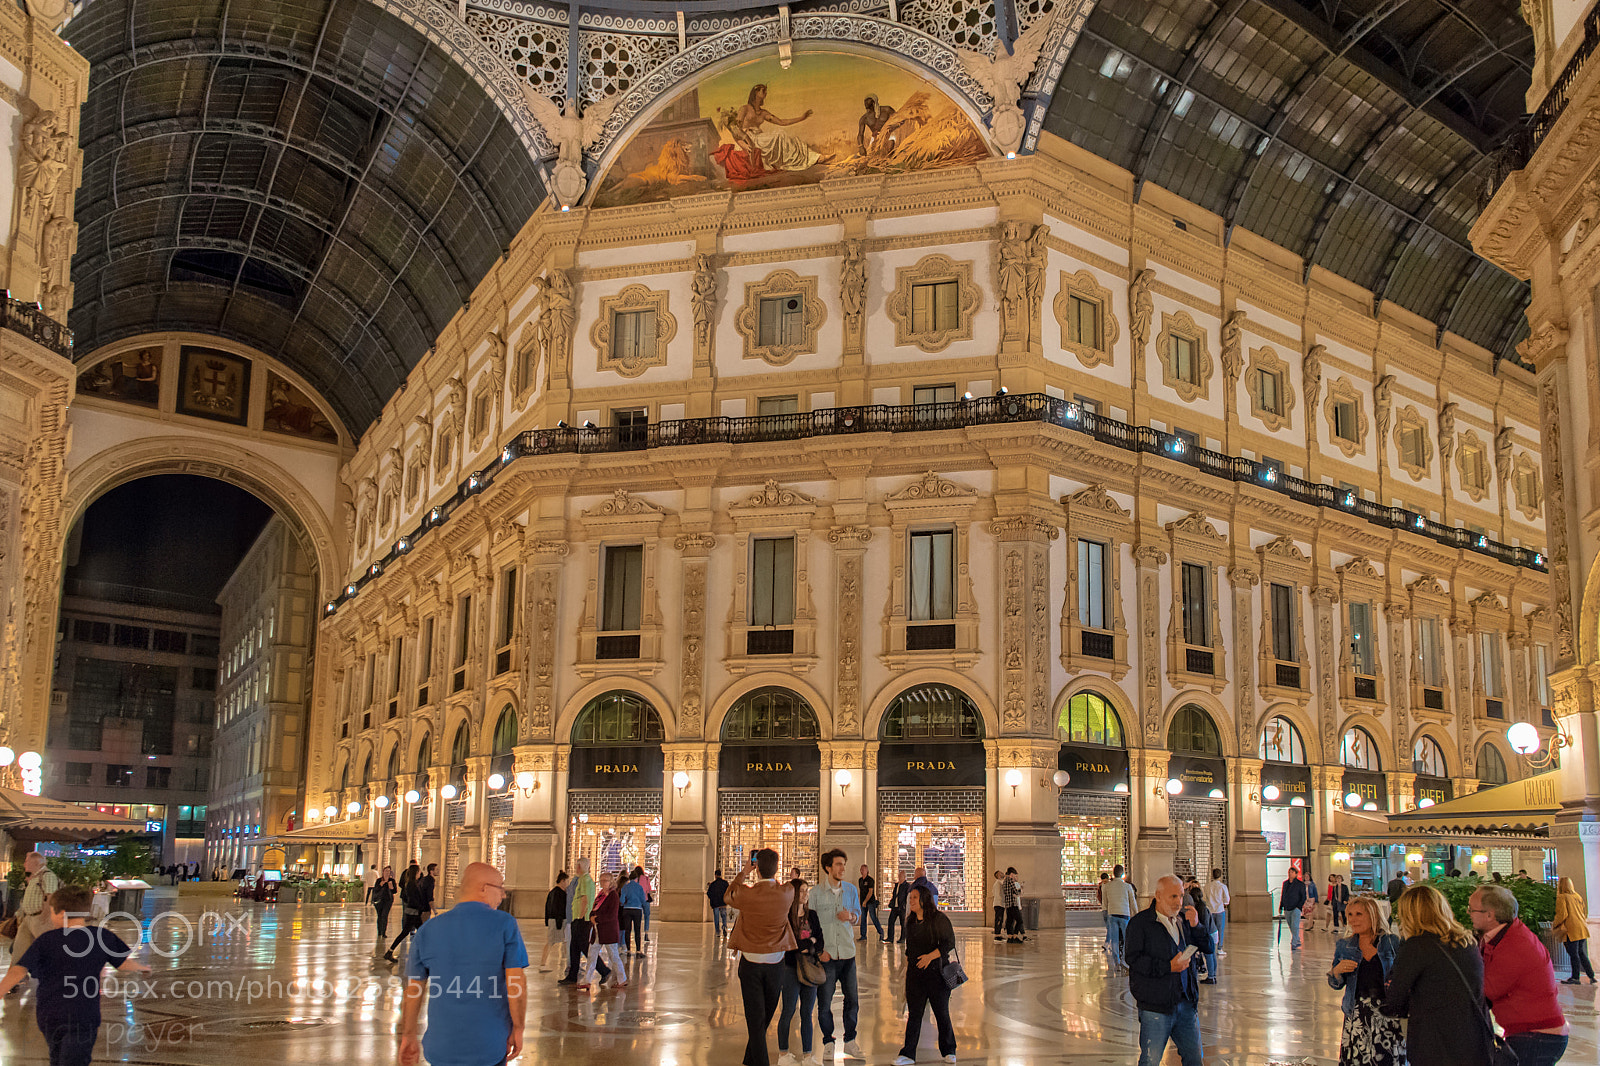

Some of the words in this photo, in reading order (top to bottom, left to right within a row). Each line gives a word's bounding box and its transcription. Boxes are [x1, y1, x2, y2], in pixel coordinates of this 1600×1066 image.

[595, 764, 639, 773] PRADA
[746, 762, 792, 771] PRADA
[907, 761, 956, 770] PRADA
[1076, 762, 1110, 773] PRADA
